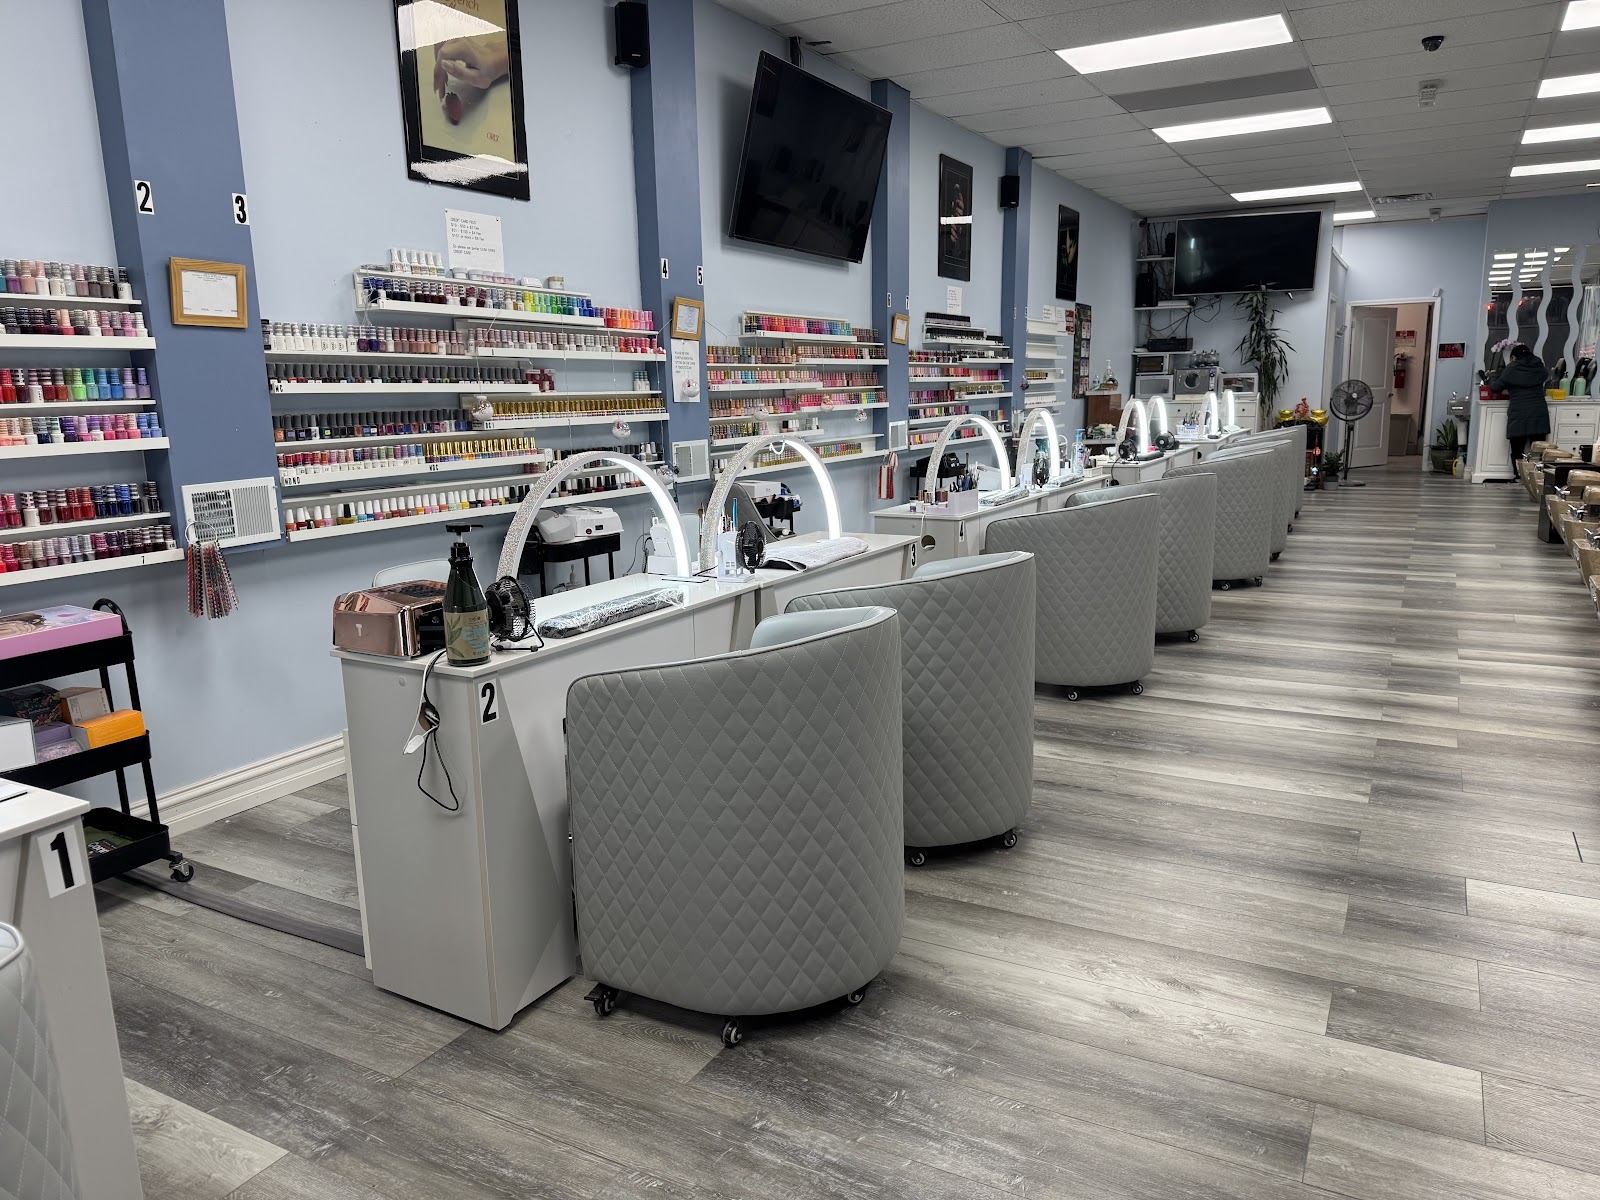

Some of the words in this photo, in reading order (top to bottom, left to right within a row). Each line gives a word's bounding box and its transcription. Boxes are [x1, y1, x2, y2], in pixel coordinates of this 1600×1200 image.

[137, 182, 152, 212] 2
[235, 196, 246, 224] 3
[662, 260, 667, 277] 4
[698, 267, 703, 284] 5
[912, 544, 915, 566] 3
[482, 682, 496, 723] 2
[50, 832, 74, 889] 1
